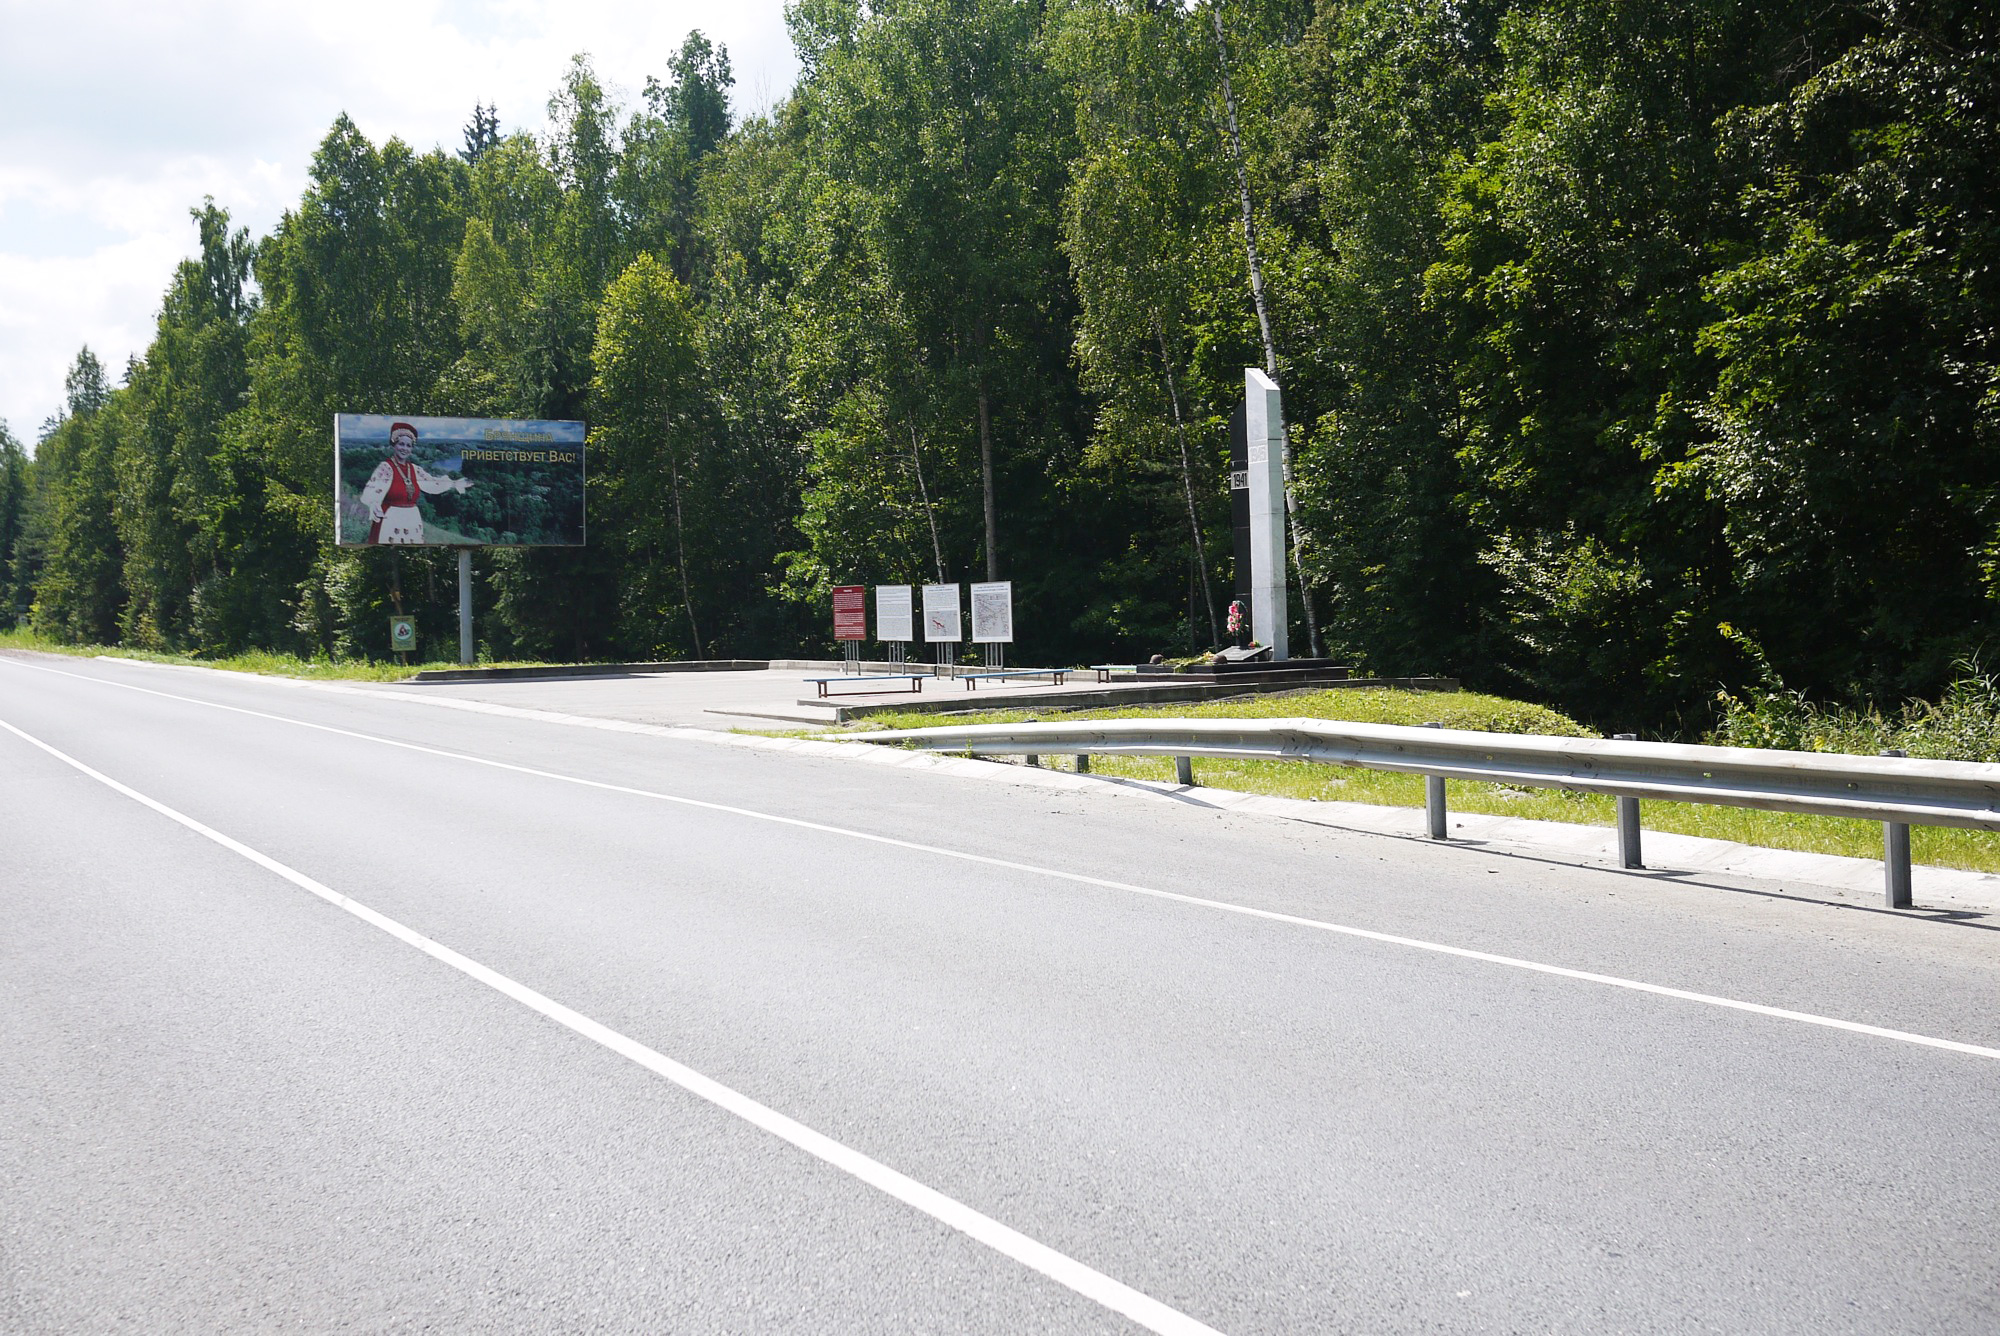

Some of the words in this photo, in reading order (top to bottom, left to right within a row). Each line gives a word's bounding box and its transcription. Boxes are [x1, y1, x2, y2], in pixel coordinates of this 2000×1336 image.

[461, 449, 546, 462] ПРИВЕТСТВУЕТ
[549, 450, 576, 463] ВАС!
[1233, 472, 1248, 488] 1941
